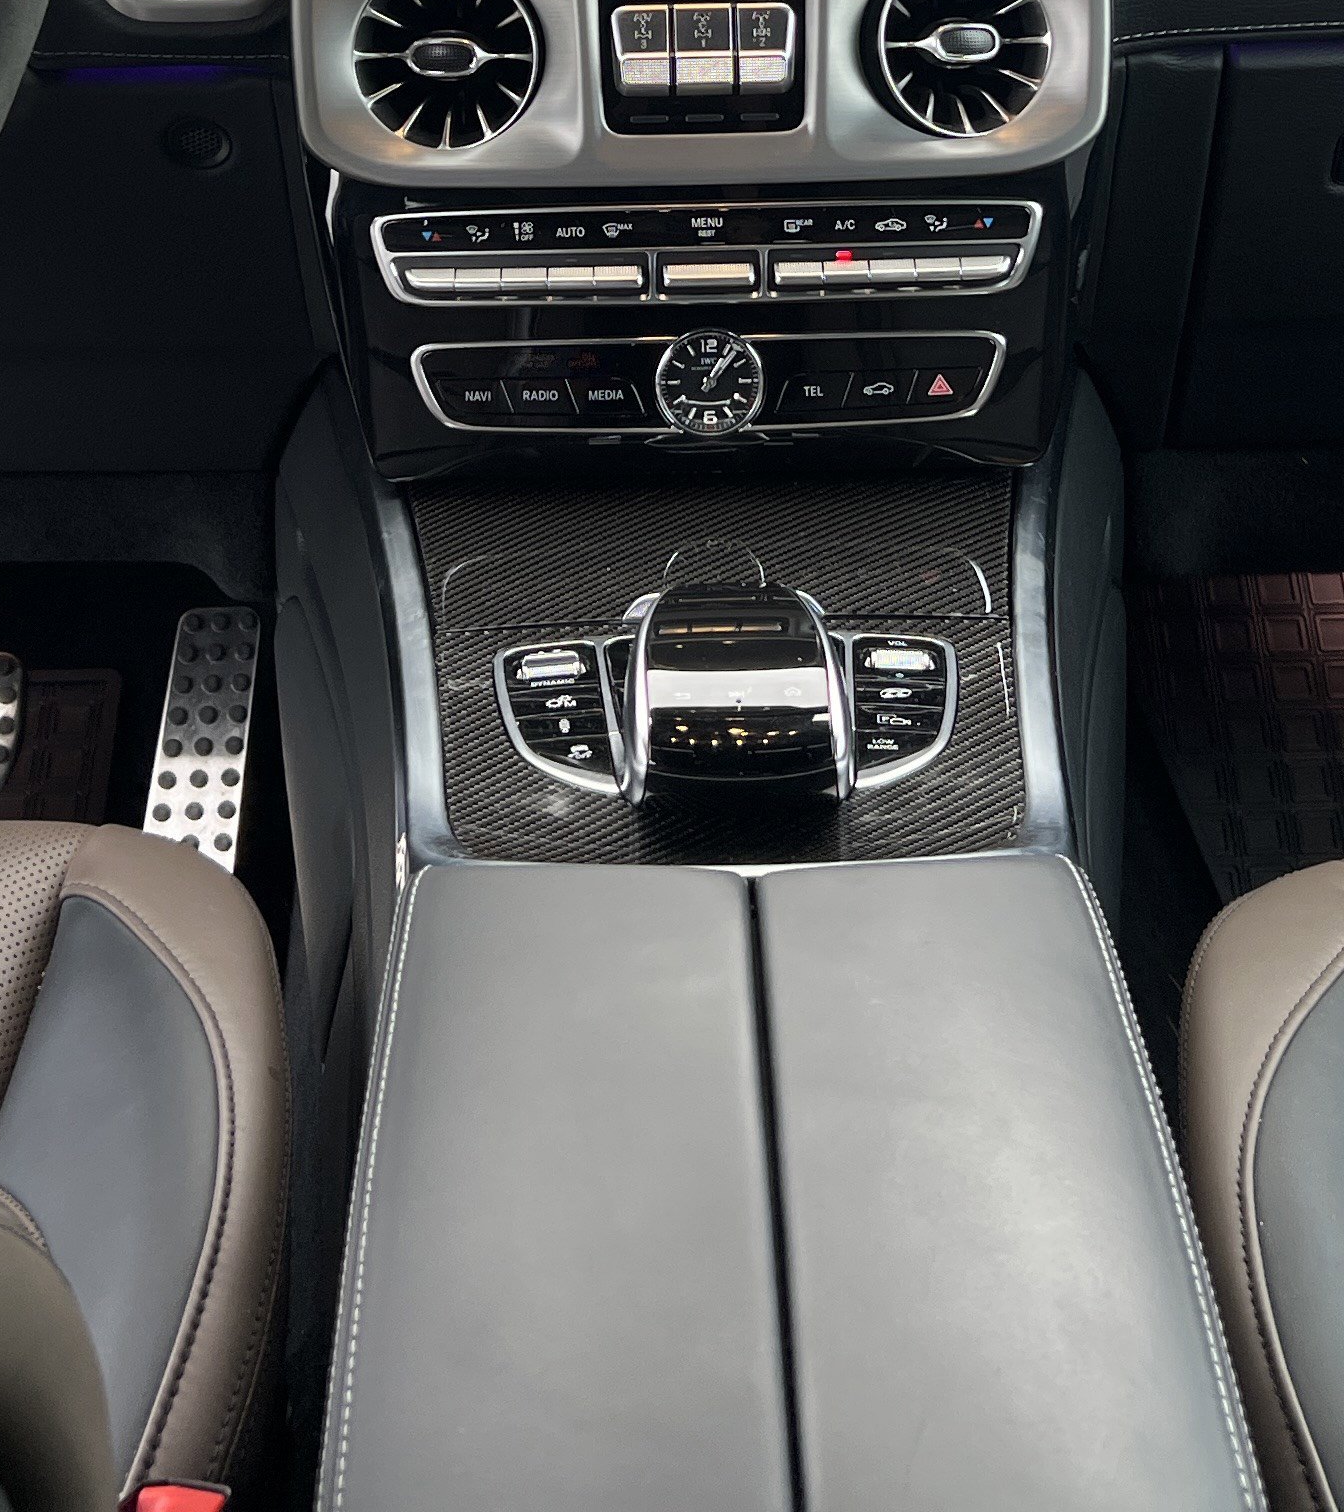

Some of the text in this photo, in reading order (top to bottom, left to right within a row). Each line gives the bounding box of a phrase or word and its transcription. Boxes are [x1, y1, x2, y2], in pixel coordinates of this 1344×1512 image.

[618, 223, 634, 231] MAX
[690, 216, 724, 229] MENU
[834, 219, 857, 231] A/C
[520, 233, 534, 242] OFF
[555, 226, 586, 238] AUTO
[700, 338, 719, 354] 12
[464, 390, 492, 402] NAVI
[522, 390, 559, 402] RADIO
[588, 389, 624, 401] MEDIA
[803, 385, 824, 397] TEL
[702, 409, 719, 426] 6
[530, 677, 576, 688] DYNAMIC
